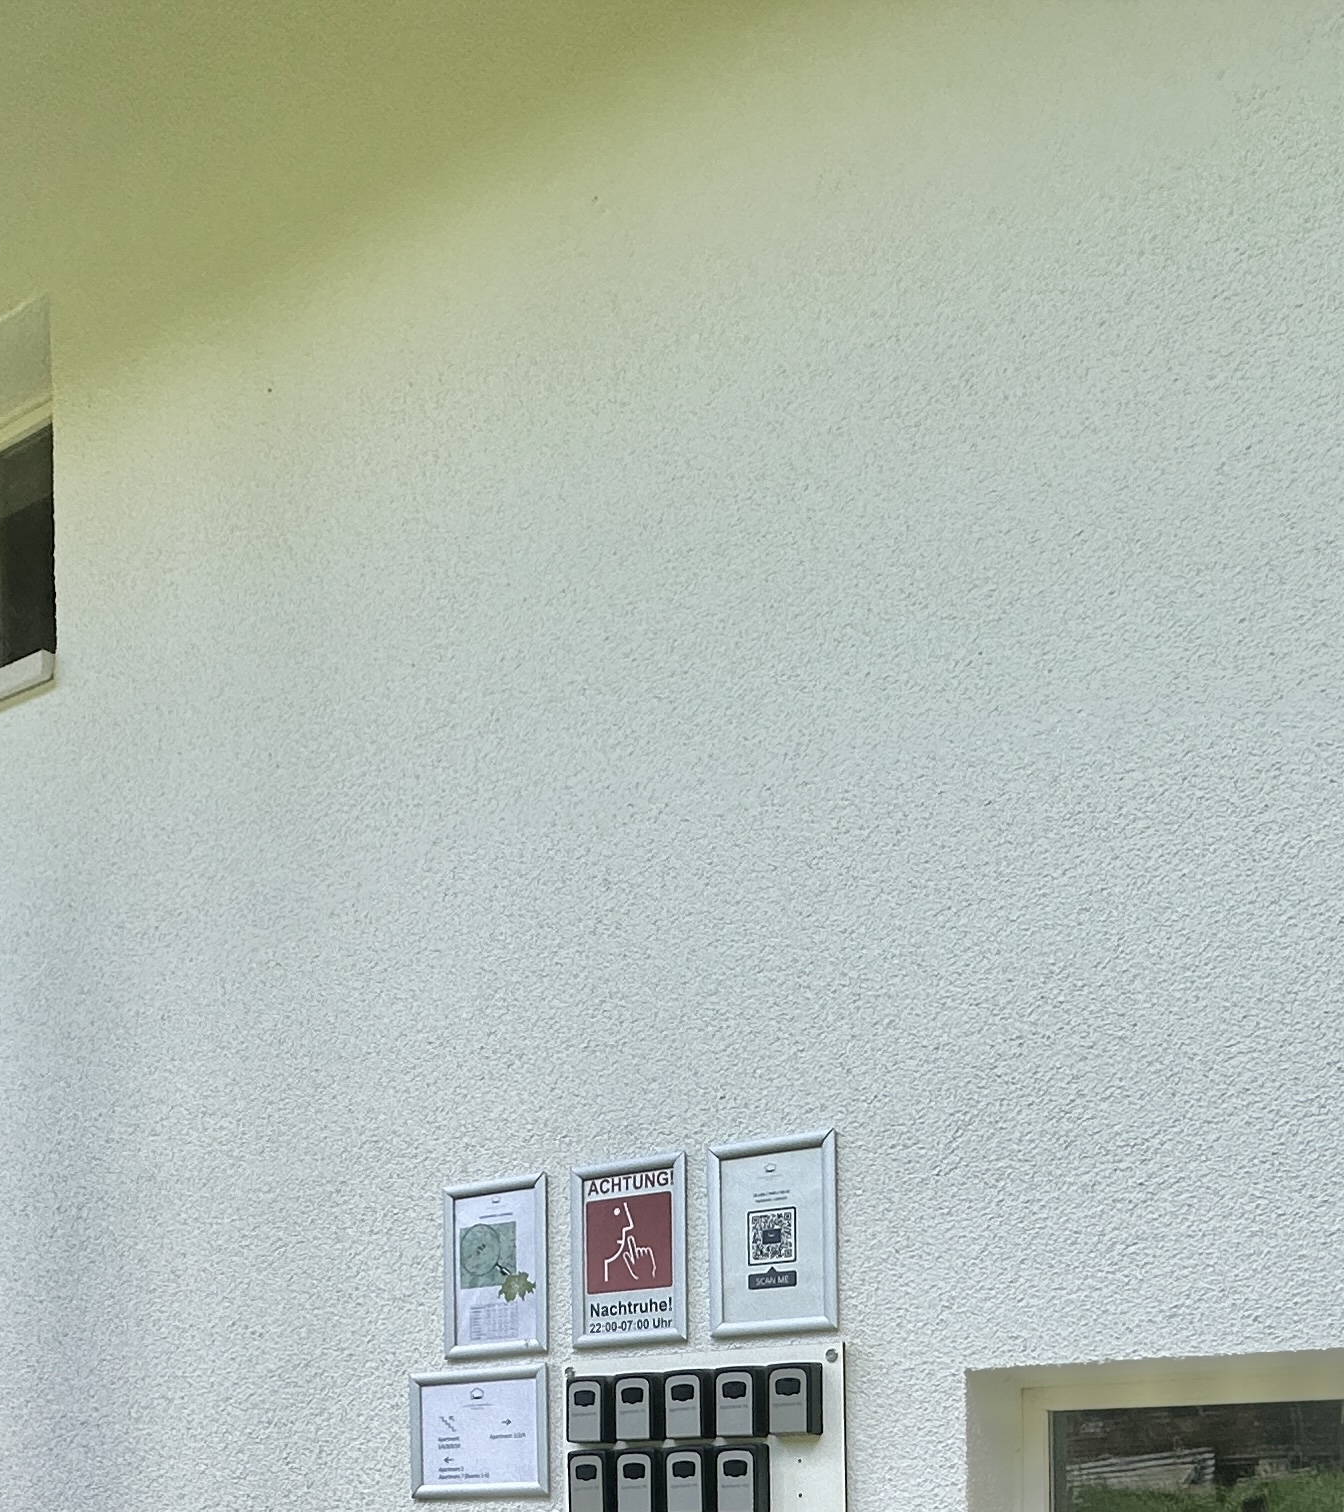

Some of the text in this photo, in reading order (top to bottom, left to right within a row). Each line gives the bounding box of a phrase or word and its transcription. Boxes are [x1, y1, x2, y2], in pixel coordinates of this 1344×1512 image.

[587, 1170, 674, 1197] ACHTUNG!
[755, 1276, 776, 1286] SCAN
[590, 1296, 673, 1318] Nachtruhe!
[589, 1317, 673, 1334] 22:00-07:00 Uhr
